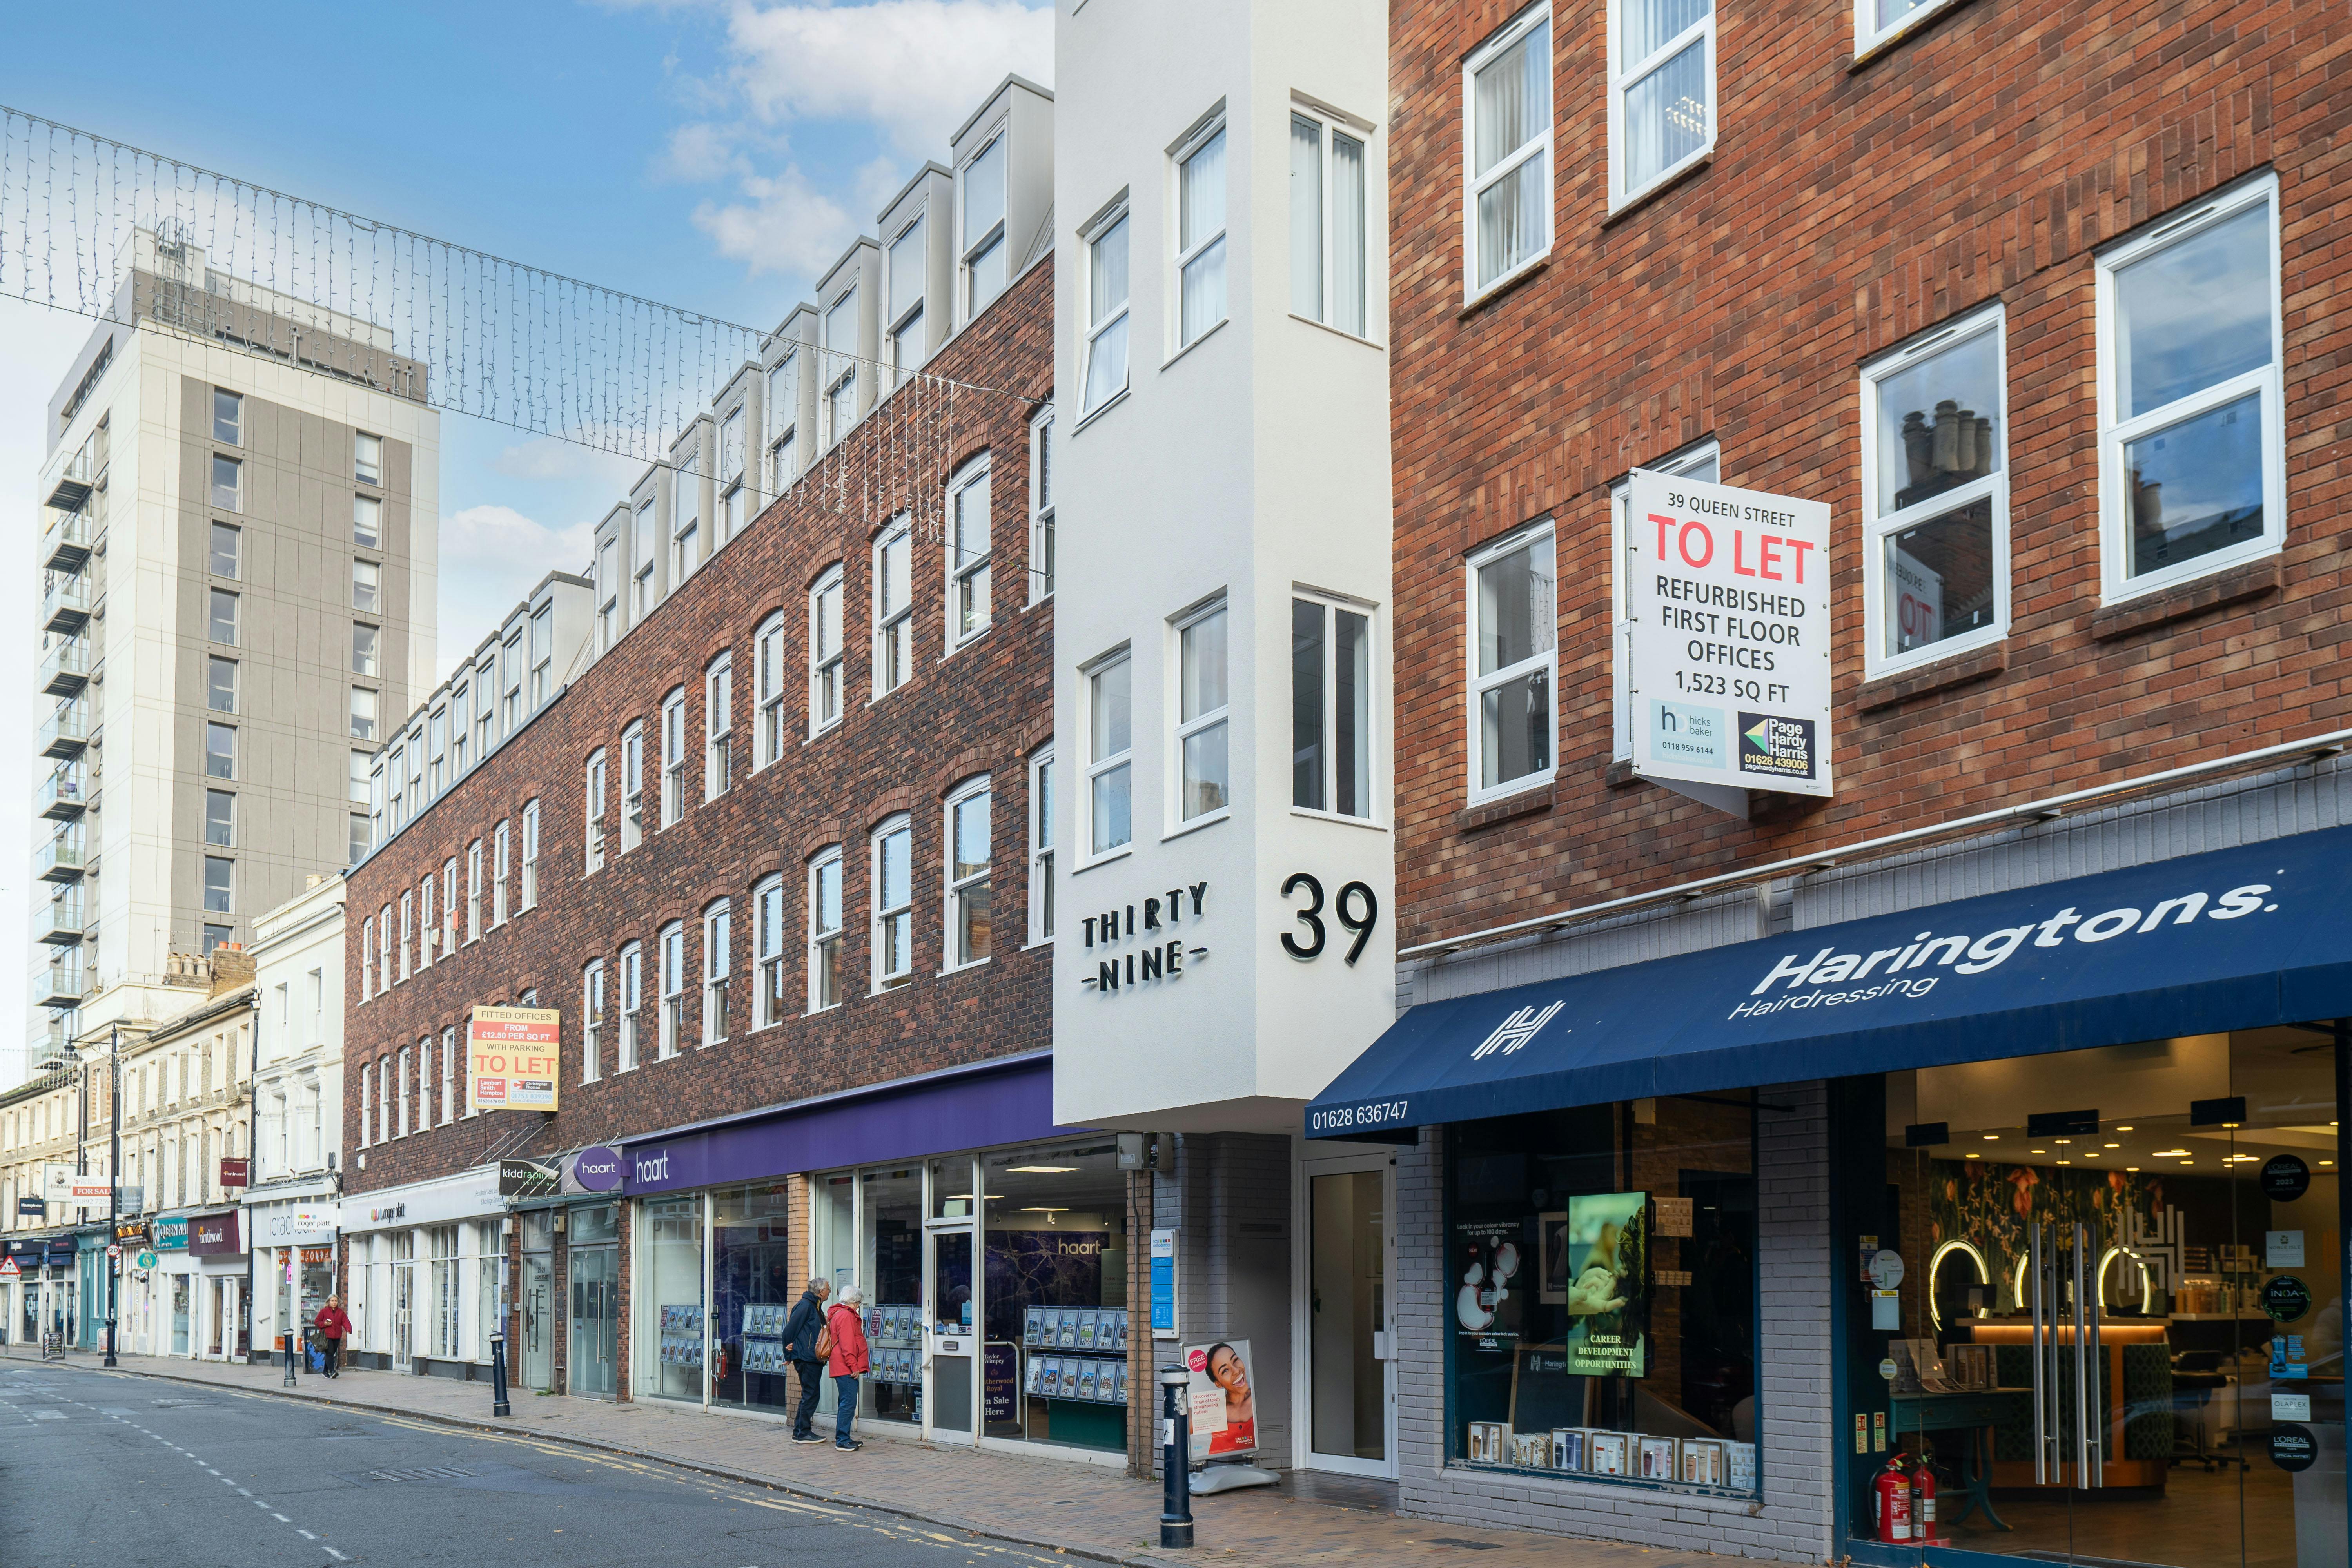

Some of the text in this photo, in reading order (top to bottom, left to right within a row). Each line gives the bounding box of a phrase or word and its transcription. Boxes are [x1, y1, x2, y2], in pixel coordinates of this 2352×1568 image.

[1668, 492, 1795, 528] 39 QUEEN STREET
[1648, 513, 1814, 584] TO LET
[1657, 575, 1806, 618] REFURBISHED
[1662, 606, 1800, 646] FIRST FLOOR
[1688, 640, 1775, 671] OFFICES
[1675, 670, 1789, 704] 1,523 SQ FT
[1690, 715, 1711, 727] hicks
[1769, 718, 1803, 736] Page
[1690, 726, 1713, 737] baker
[1662, 741, 1679, 750] 0118
[1696, 746, 1713, 755] 6144
[1769, 733, 1806, 750] Hardy
[1769, 743, 1808, 760] Harris
[1745, 753, 1808, 769] 01628 439006
[1745, 763, 1808, 776] pagehardyharris.co.uk
[1082, 881, 1208, 947] THIRTY
[1280, 873, 1378, 965] 39
[1750, 884, 2279, 996] Haringtons.
[1728, 977, 1939, 1020] Hairdressing
[475, 1055, 555, 1074] TO LET
[1313, 1101, 1407, 1130] 01628 636747
[582, 1162, 615, 1174] haart
[636, 1149, 668, 1183] haart
[383, 1201, 406, 1223] roger platt
[200, 1228, 223, 1244] northwood
[1058, 1238, 1101, 1255] haart
[1590, 1335, 1621, 1344] CAREER
[1189, 1354, 1205, 1365] FREE
[1578, 1347, 1633, 1357] DEVELOPMENT
[1575, 1359, 1637, 1369] OPPORTUNITIES
